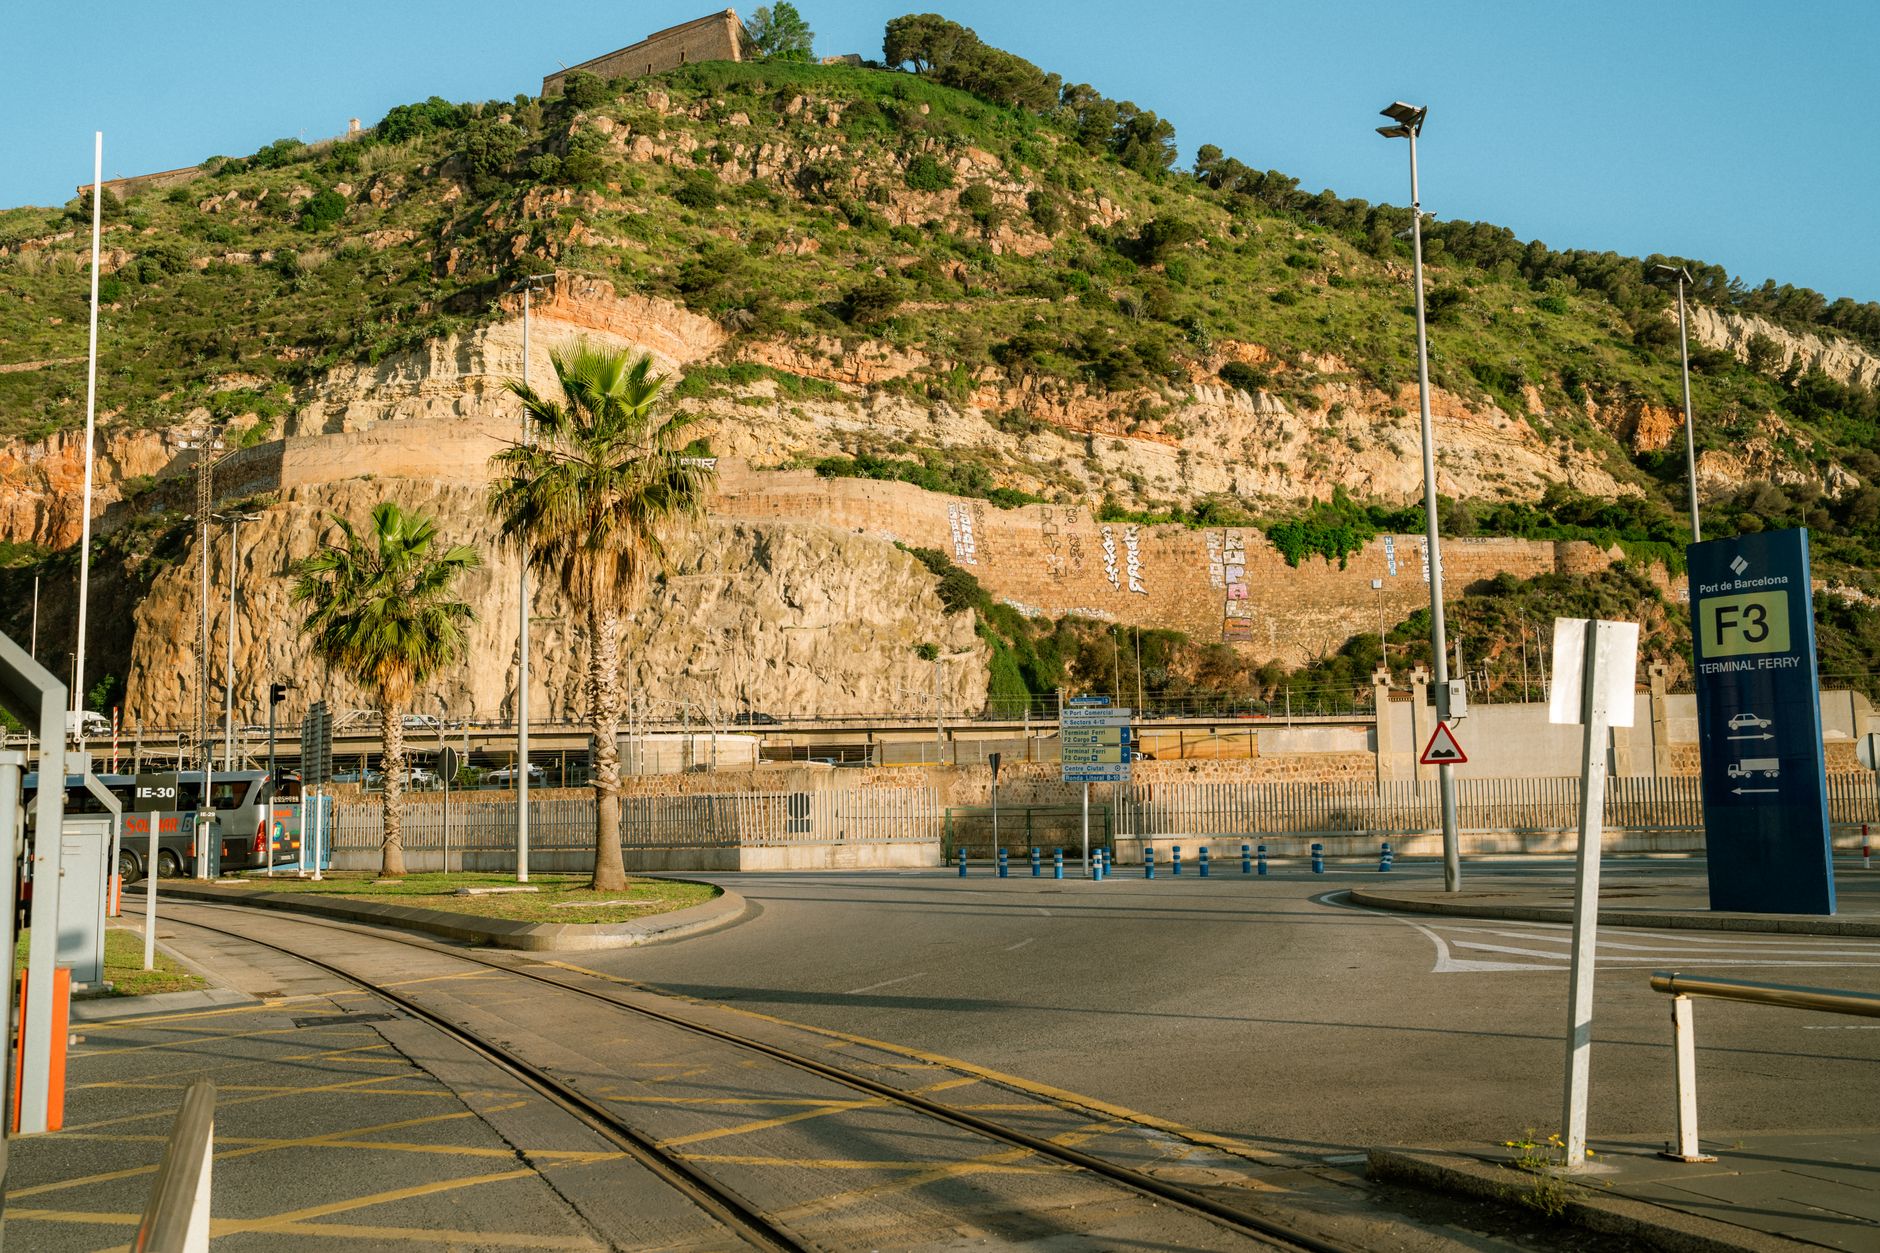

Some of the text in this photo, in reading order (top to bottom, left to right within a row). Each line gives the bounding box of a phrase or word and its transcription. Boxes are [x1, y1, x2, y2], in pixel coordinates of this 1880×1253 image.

[1699, 575, 1789, 594] Port de Barcelona
[1715, 603, 1769, 646] F3
[1699, 656, 1801, 675] TERMINAL FERRY
[136, 787, 176, 798] IE-30
